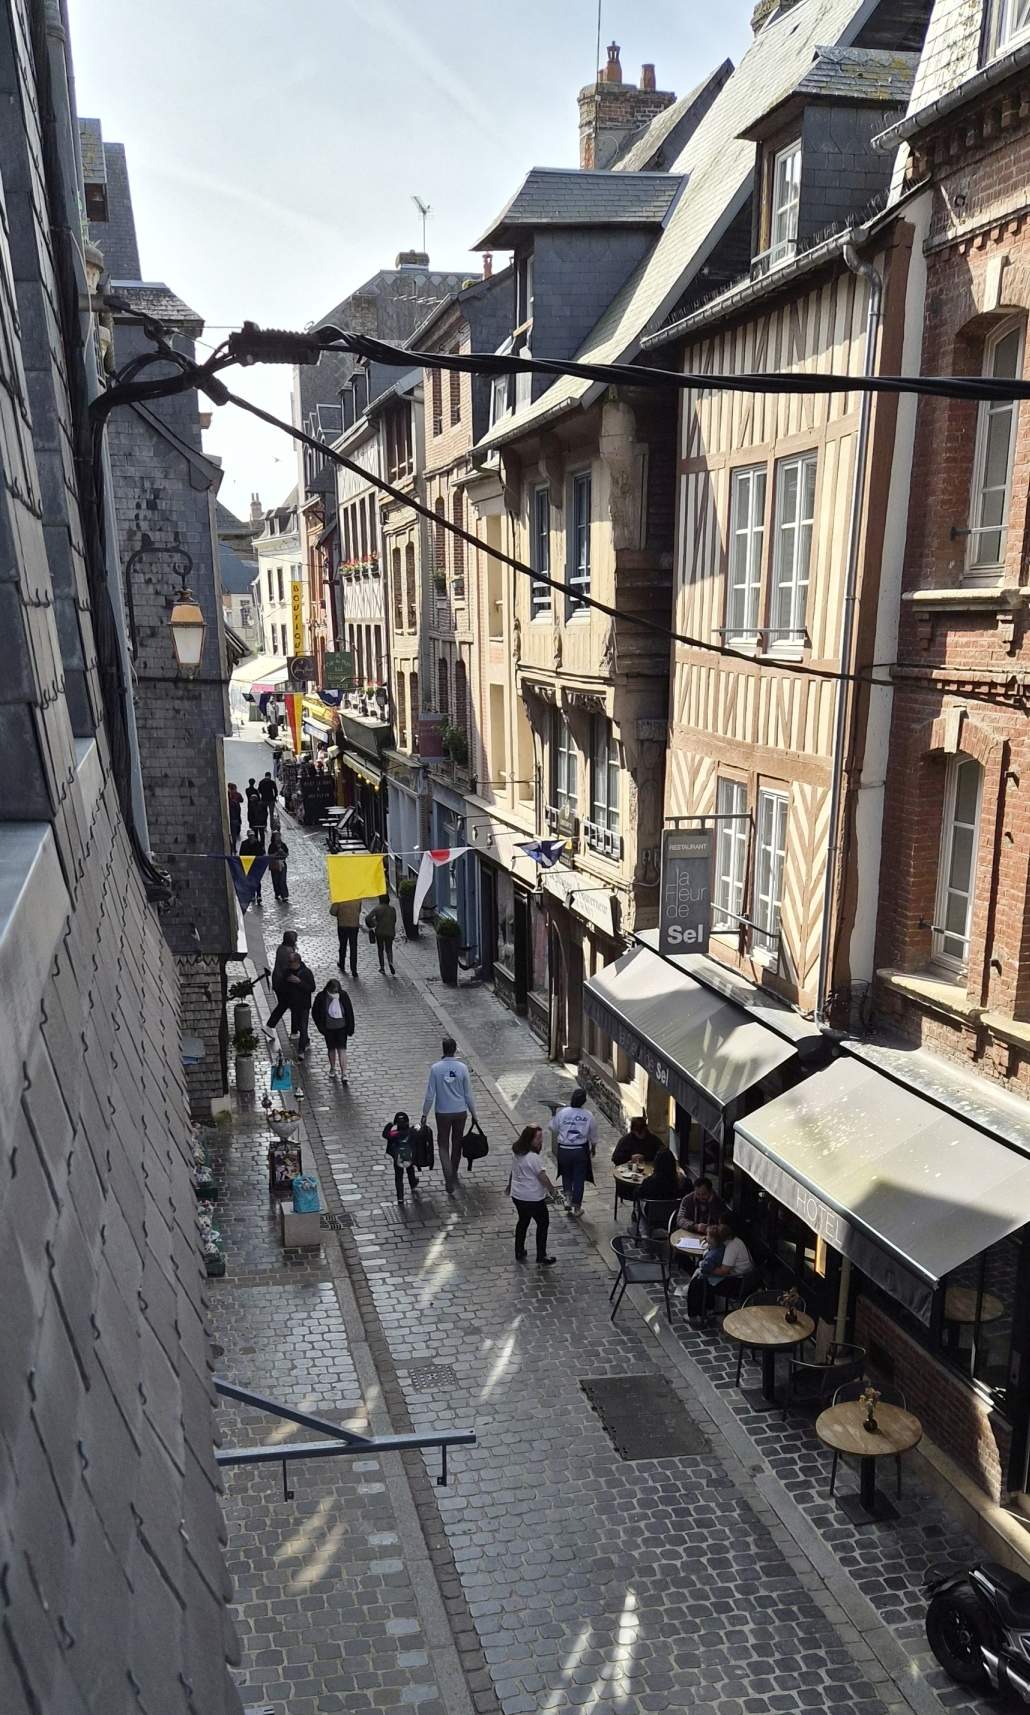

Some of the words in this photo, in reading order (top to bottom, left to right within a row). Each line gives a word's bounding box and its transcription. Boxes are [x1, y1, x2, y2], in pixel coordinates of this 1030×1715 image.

[669, 843, 707, 851] RESTAURANT
[666, 883, 706, 902] Fleur
[666, 903, 690, 918] de
[667, 924, 704, 944] Sel
[655, 1062, 669, 1087] Sel
[796, 1187, 842, 1245] HOTEL
